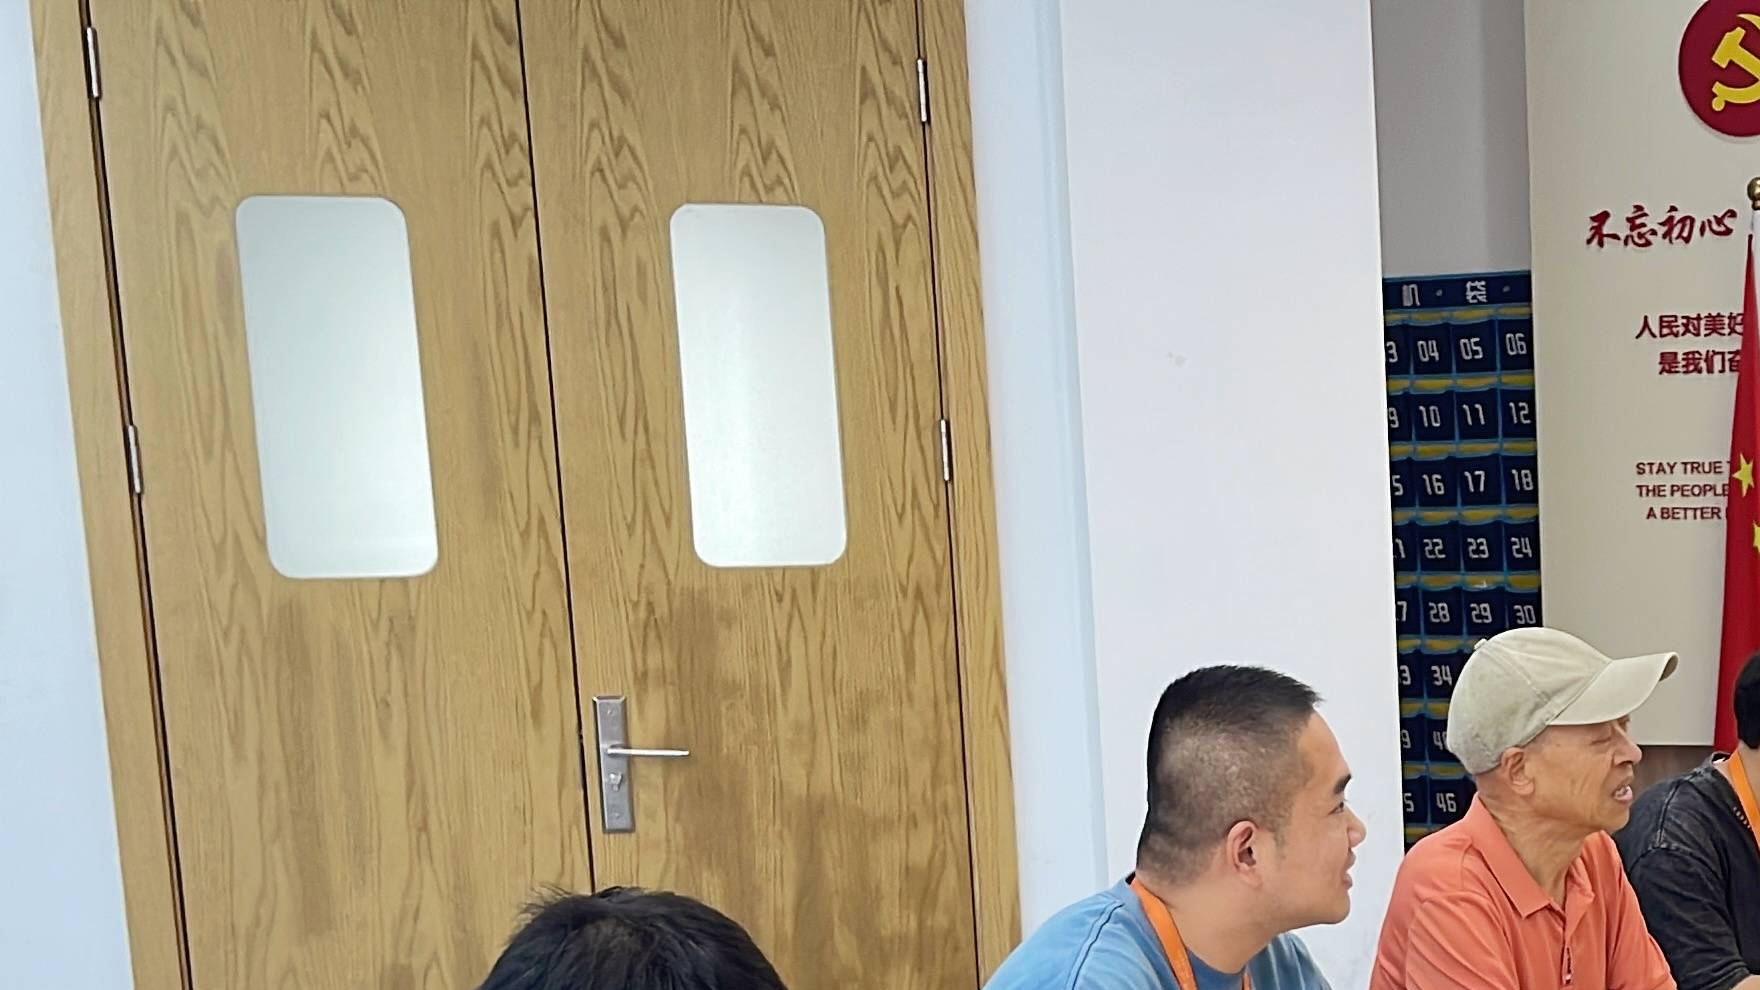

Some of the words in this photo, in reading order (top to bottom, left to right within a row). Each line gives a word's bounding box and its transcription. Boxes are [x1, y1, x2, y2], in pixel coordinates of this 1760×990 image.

[1586, 204, 1738, 249] 不忘初心
[1417, 340, 1439, 362] 04
[1460, 337, 1483, 360] 05
[1505, 333, 1527, 355] 06
[1419, 405, 1441, 427] 10
[1463, 403, 1486, 426] 11
[1509, 402, 1532, 424] 12
[1636, 462, 1677, 476] STAY
[1681, 461, 1723, 475] TRUE
[1422, 474, 1445, 495] 16
[1464, 470, 1486, 493] 17
[1511, 469, 1533, 491] 18
[1636, 484, 1667, 498] THE
[1646, 506, 1657, 520] A
[1660, 506, 1721, 520] BETTER
[1423, 538, 1446, 559] 22
[1467, 537, 1489, 559] 23
[1511, 536, 1533, 559] 24
[1428, 602, 1450, 624] 28
[1470, 602, 1493, 624] 29
[1515, 604, 1536, 625] 30
[1431, 664, 1453, 687] 34
[1436, 792, 1457, 813] 46
